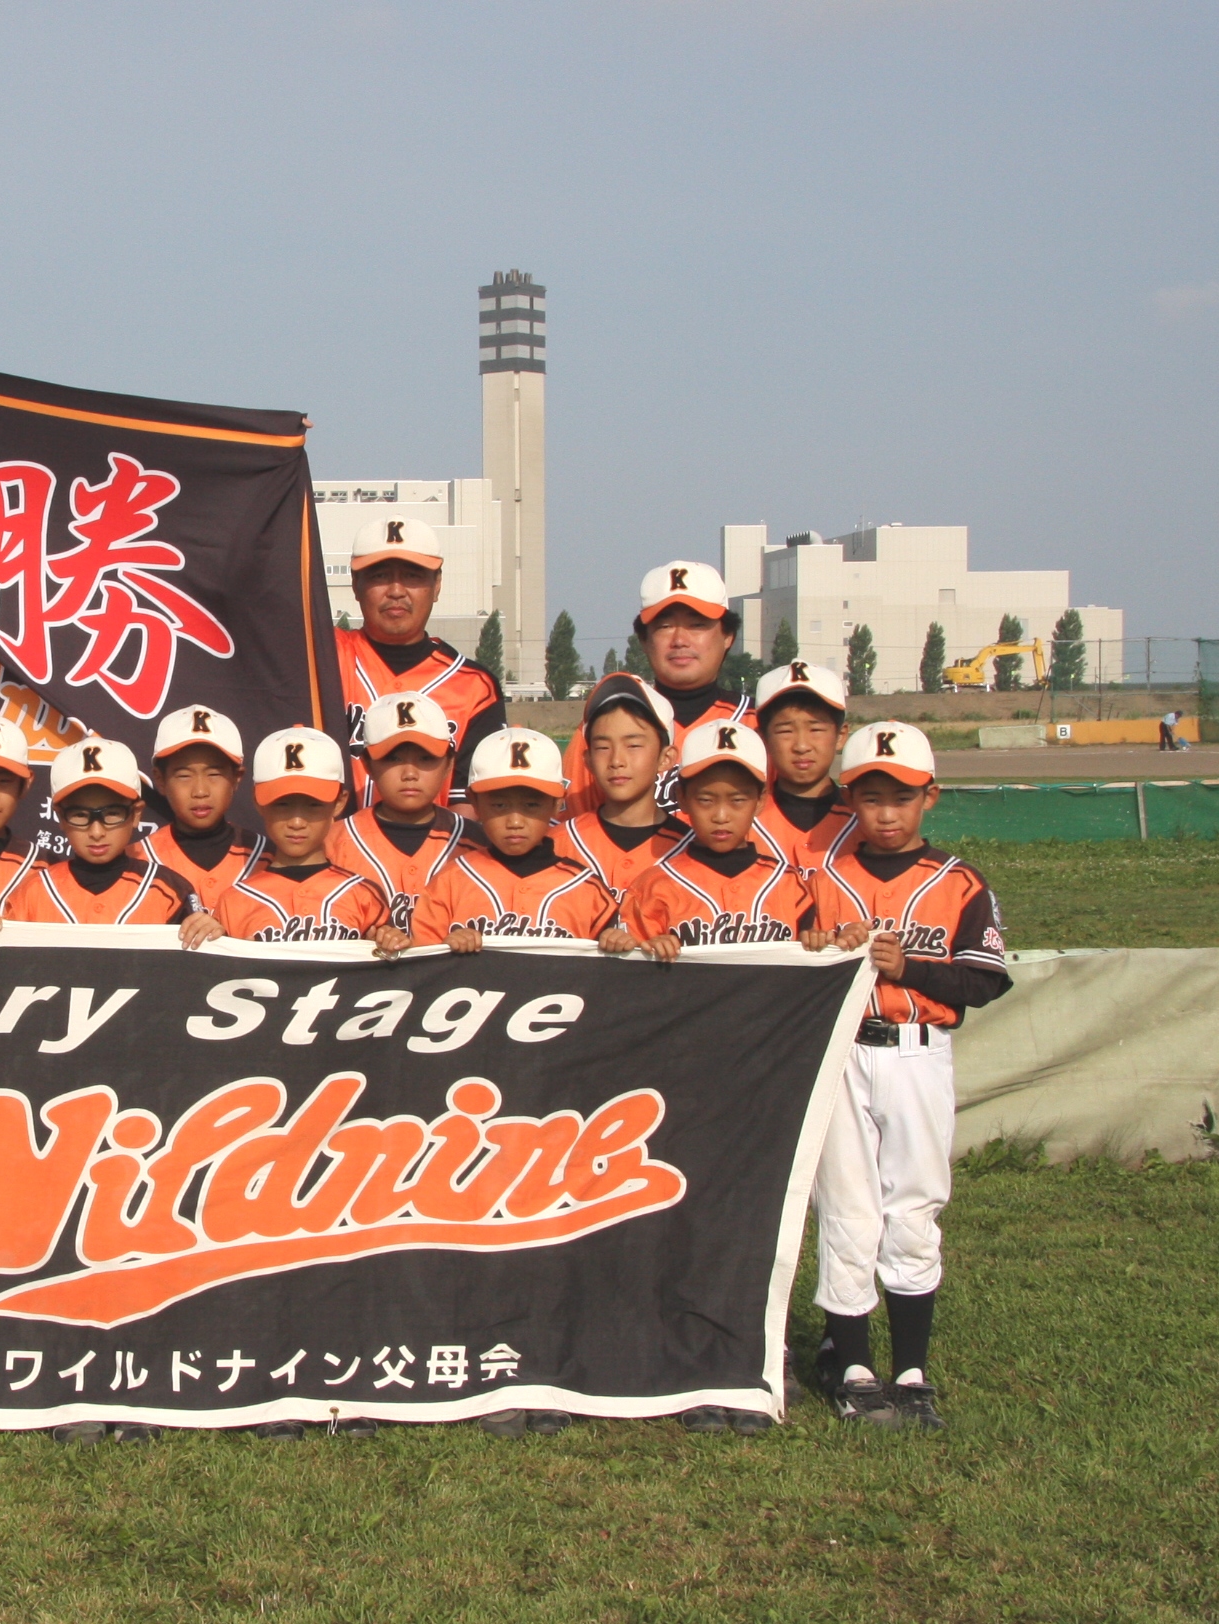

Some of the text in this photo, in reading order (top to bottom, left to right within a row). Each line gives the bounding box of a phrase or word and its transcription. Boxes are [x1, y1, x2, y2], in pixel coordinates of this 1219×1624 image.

[386, 521, 404, 543] K
[670, 568, 688, 591] K
[790, 661, 809, 683] K
[192, 710, 211, 733] K
[396, 701, 416, 726] K
[717, 727, 737, 750] K
[1059, 726, 1068, 737] B
[285, 743, 304, 770] K
[511, 742, 530, 768] K
[876, 732, 896, 757] K
[82, 746, 103, 773] K
[186, 977, 585, 1054] Stage
